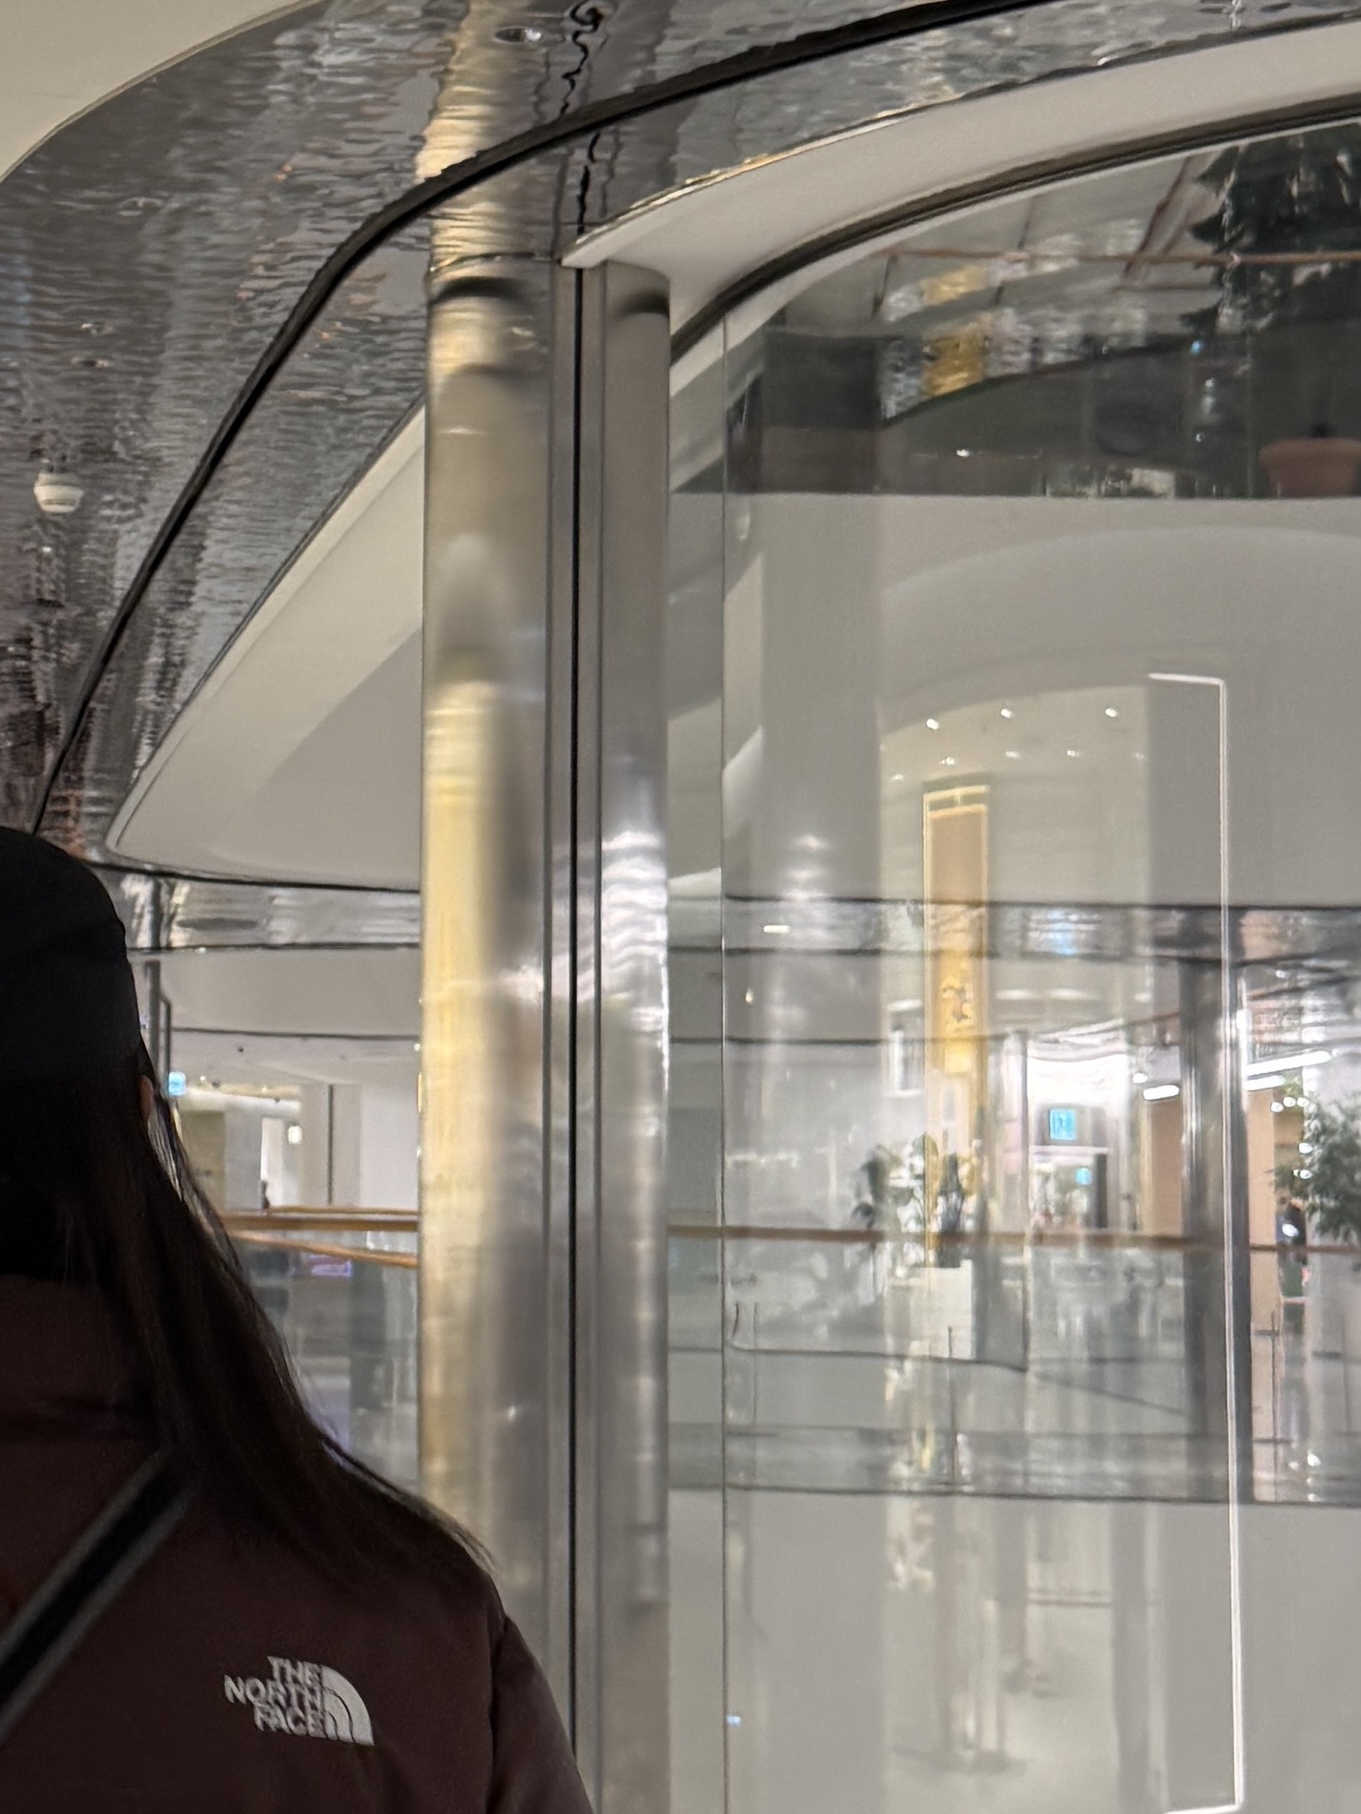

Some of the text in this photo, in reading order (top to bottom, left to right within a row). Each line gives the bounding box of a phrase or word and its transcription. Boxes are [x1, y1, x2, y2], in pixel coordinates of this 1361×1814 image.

[267, 1656, 323, 1686] THE
[224, 1674, 324, 1713] NORTH
[254, 1703, 326, 1738] FACE
